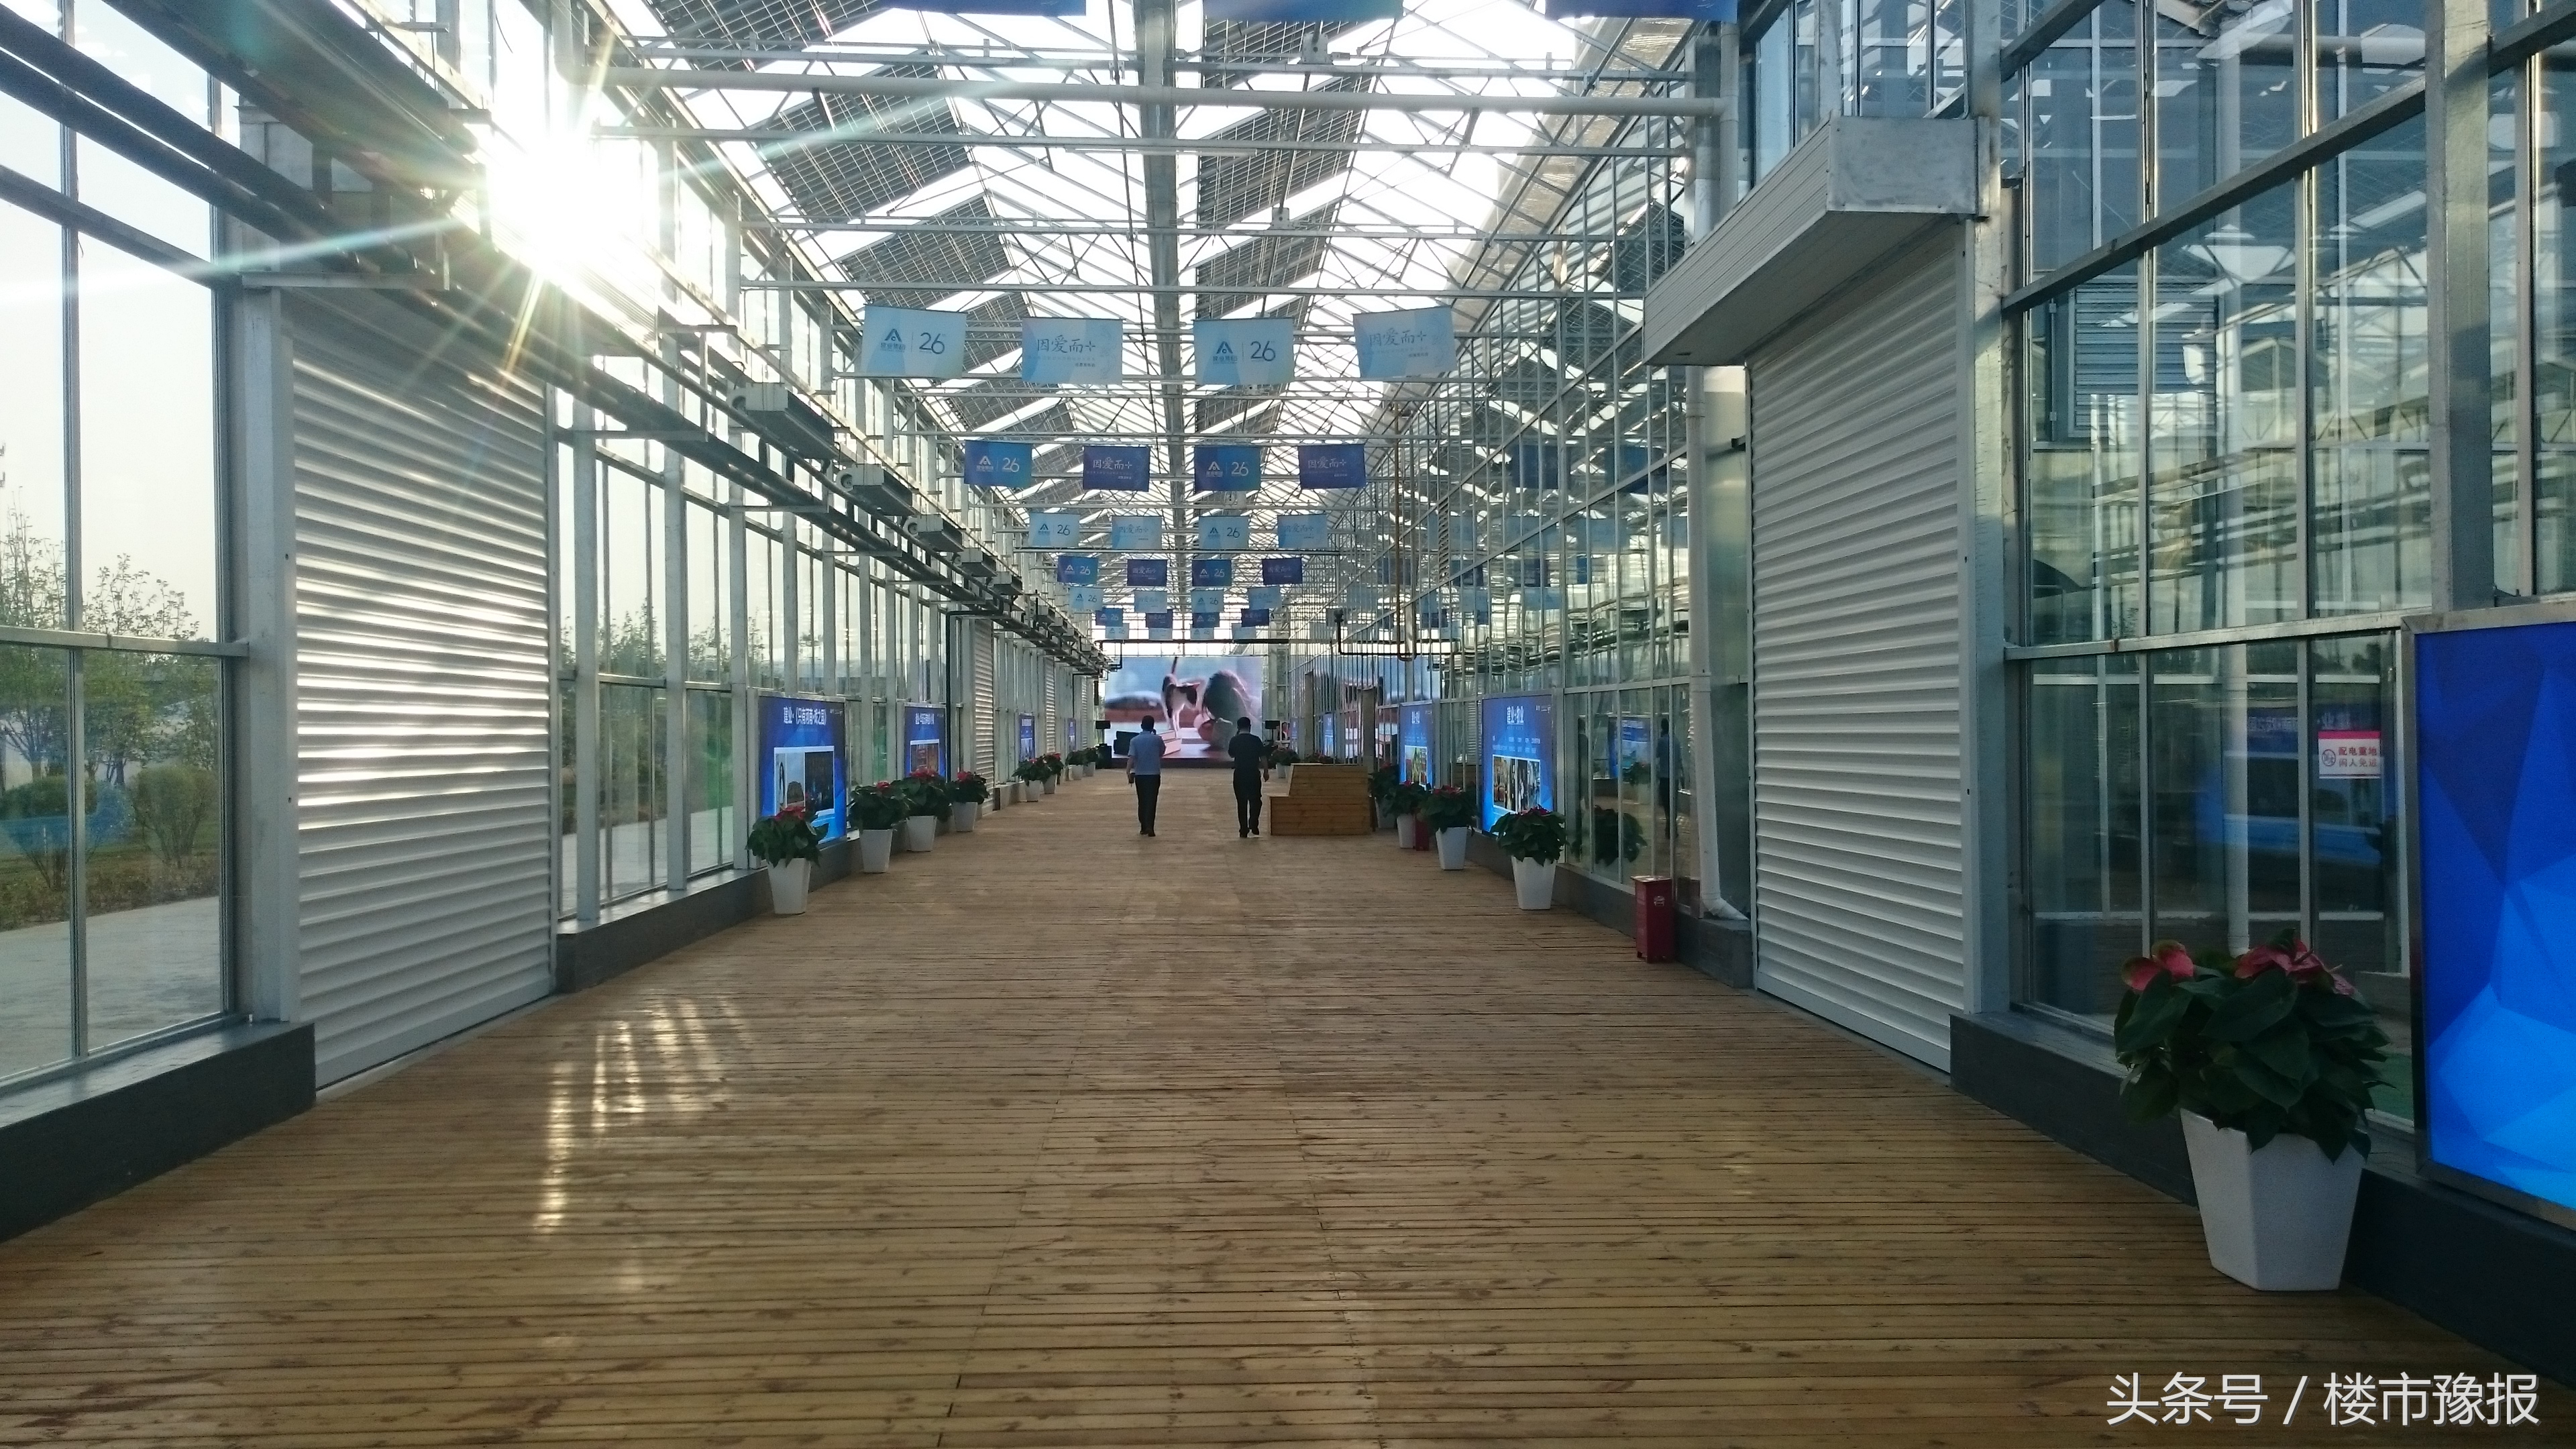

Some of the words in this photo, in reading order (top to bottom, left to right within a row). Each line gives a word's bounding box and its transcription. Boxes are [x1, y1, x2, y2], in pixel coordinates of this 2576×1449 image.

[918, 332, 945, 354] 26
[1250, 341, 1276, 362] 26
[1002, 458, 1020, 472] 26
[1231, 462, 1249, 476] 26
[1057, 524, 1071, 535] 26
[1227, 527, 1240, 538] 26
[1079, 566, 1091, 575] 26
[1214, 568, 1225, 578] 26
[1088, 594, 1097, 602] 26
[2339, 747, 2377, 756] 配电重地
